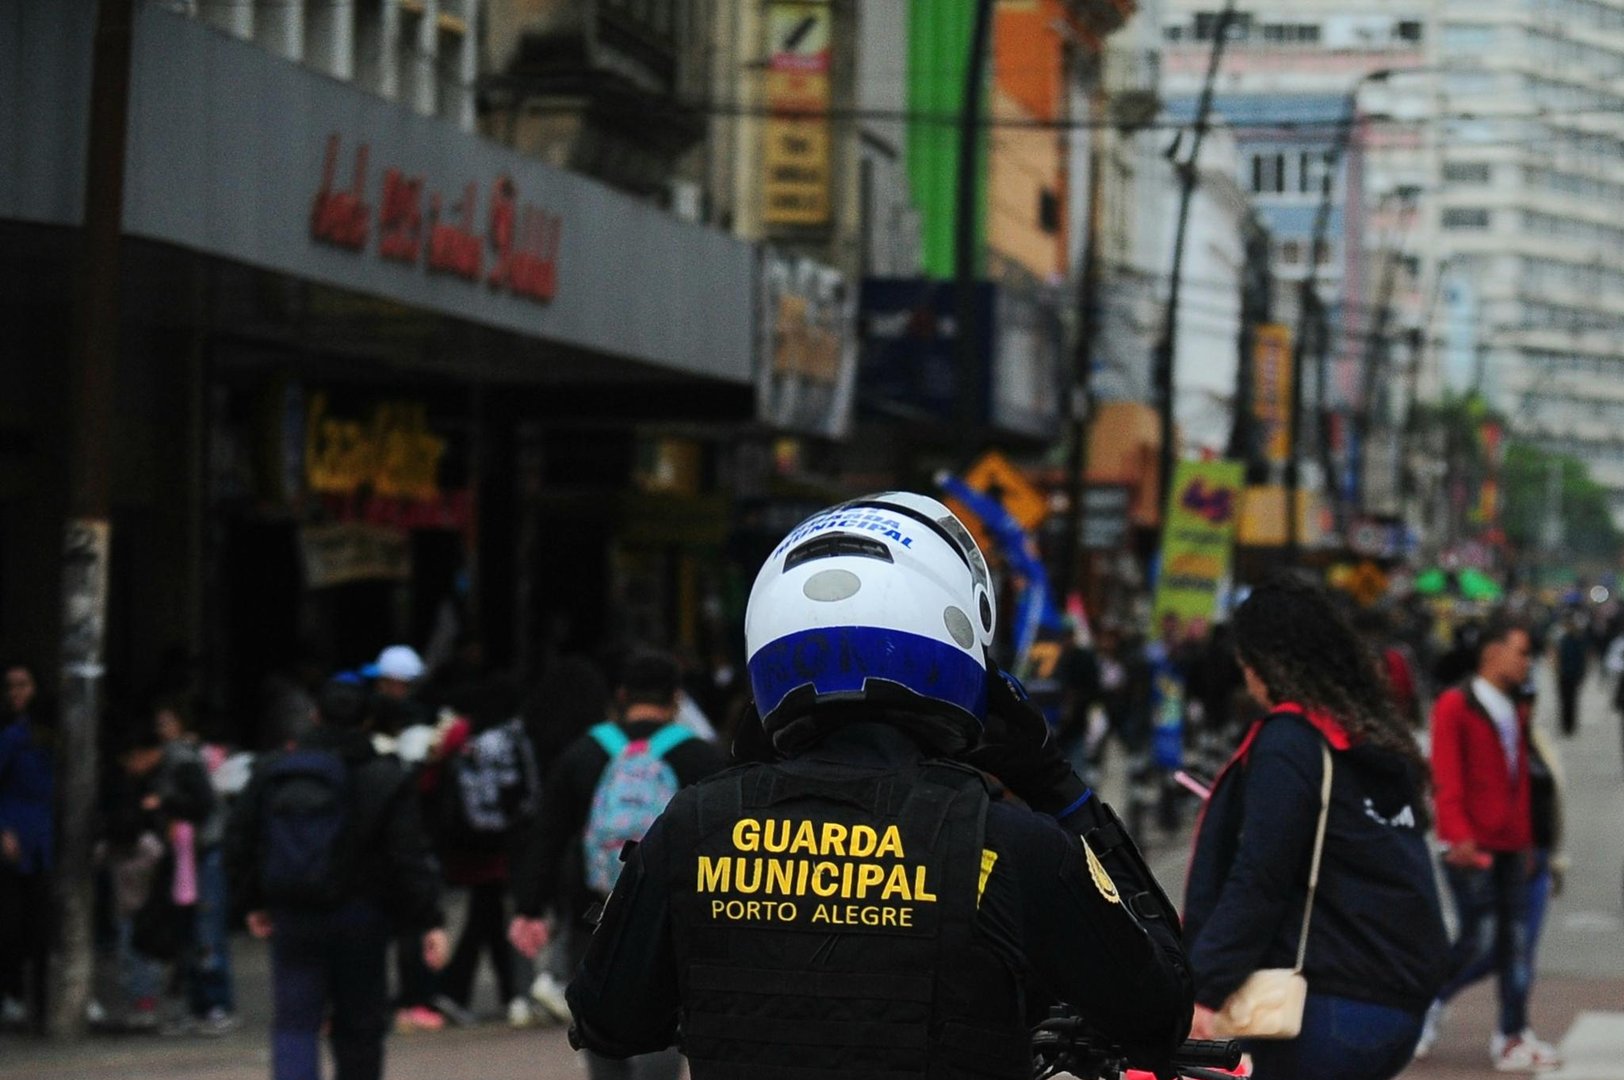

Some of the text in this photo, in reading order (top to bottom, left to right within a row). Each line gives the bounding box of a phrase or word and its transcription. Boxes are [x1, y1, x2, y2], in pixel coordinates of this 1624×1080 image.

[774, 520, 914, 559] MUNICIPAL
[732, 818, 904, 859] GUARDA
[696, 856, 937, 902] MUNICIPAL
[712, 900, 914, 927] PORTO ALEGRE
